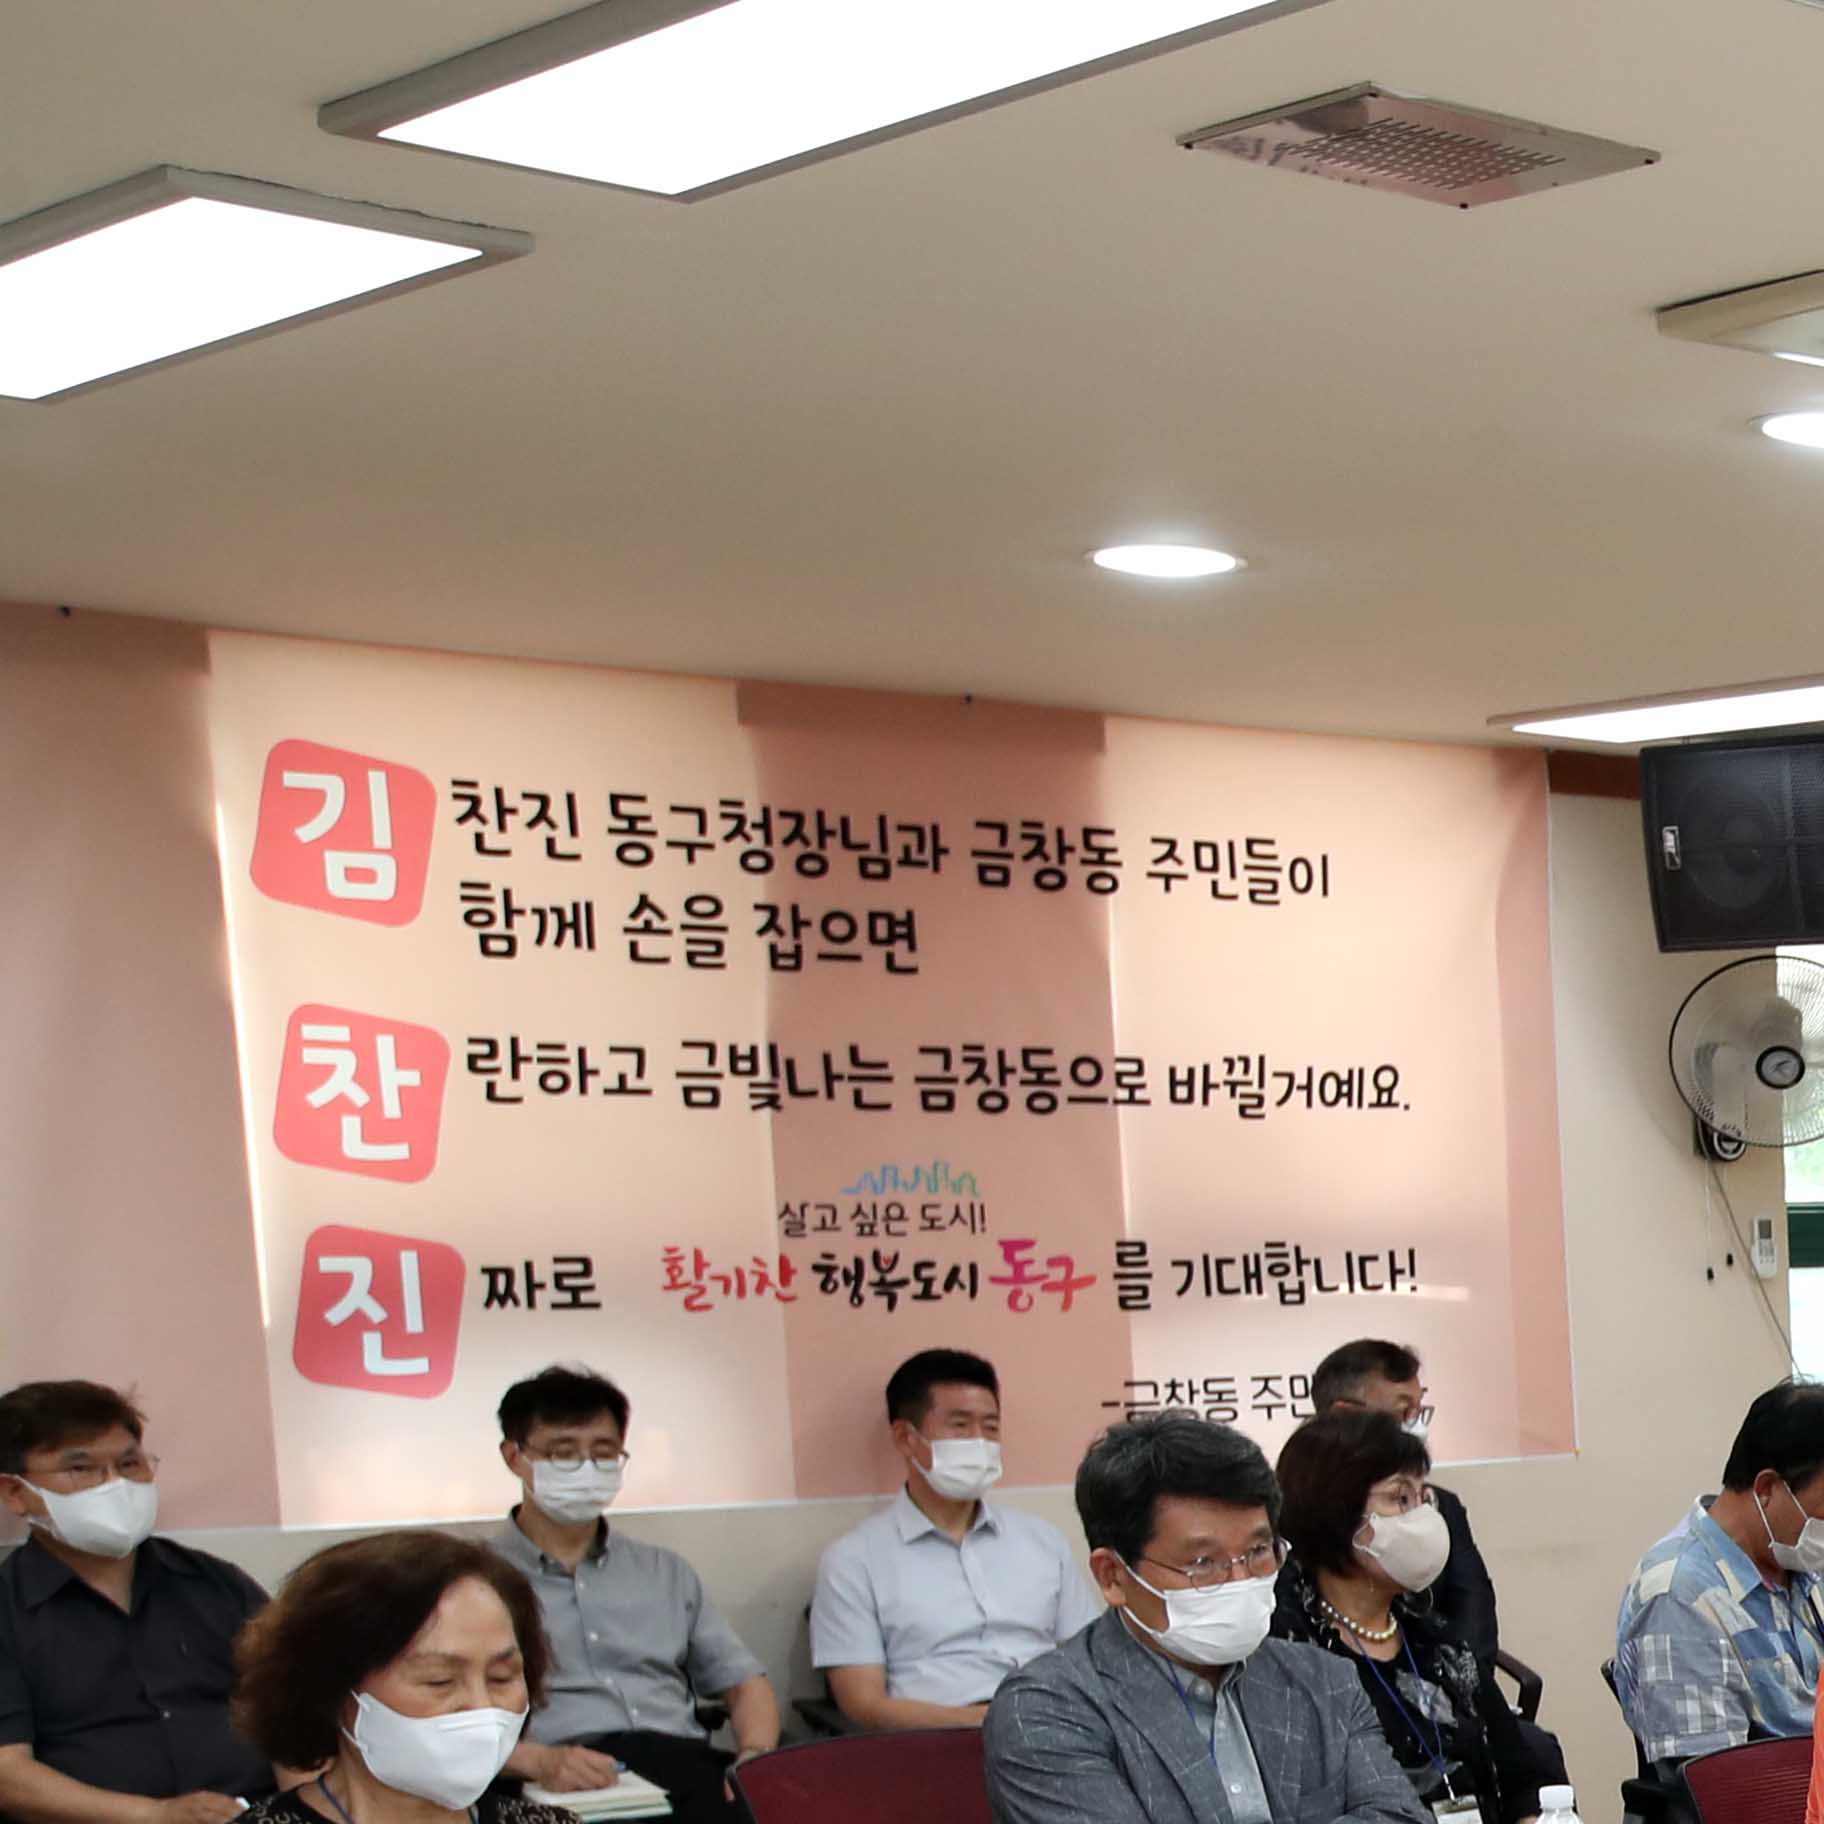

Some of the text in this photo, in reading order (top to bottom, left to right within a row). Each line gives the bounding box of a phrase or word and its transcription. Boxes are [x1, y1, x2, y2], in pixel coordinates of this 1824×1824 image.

[282, 768, 398, 901] 김
[450, 778, 1331, 906] 찬진 동구청장님과 금창동 주민들이
[458, 880, 919, 975] 함께 손을 잡으면
[300, 1023, 421, 1161] 찬
[466, 1035, 1412, 1119] 란하고 금빛나는 금창동으로 바뀔거예요.
[777, 1200, 987, 1239] 살고 싶은 도시!
[316, 1249, 430, 1376] 진
[480, 1238, 1420, 1314] 짜로 활기찬 행복도시 동구 를 기대합니다!
